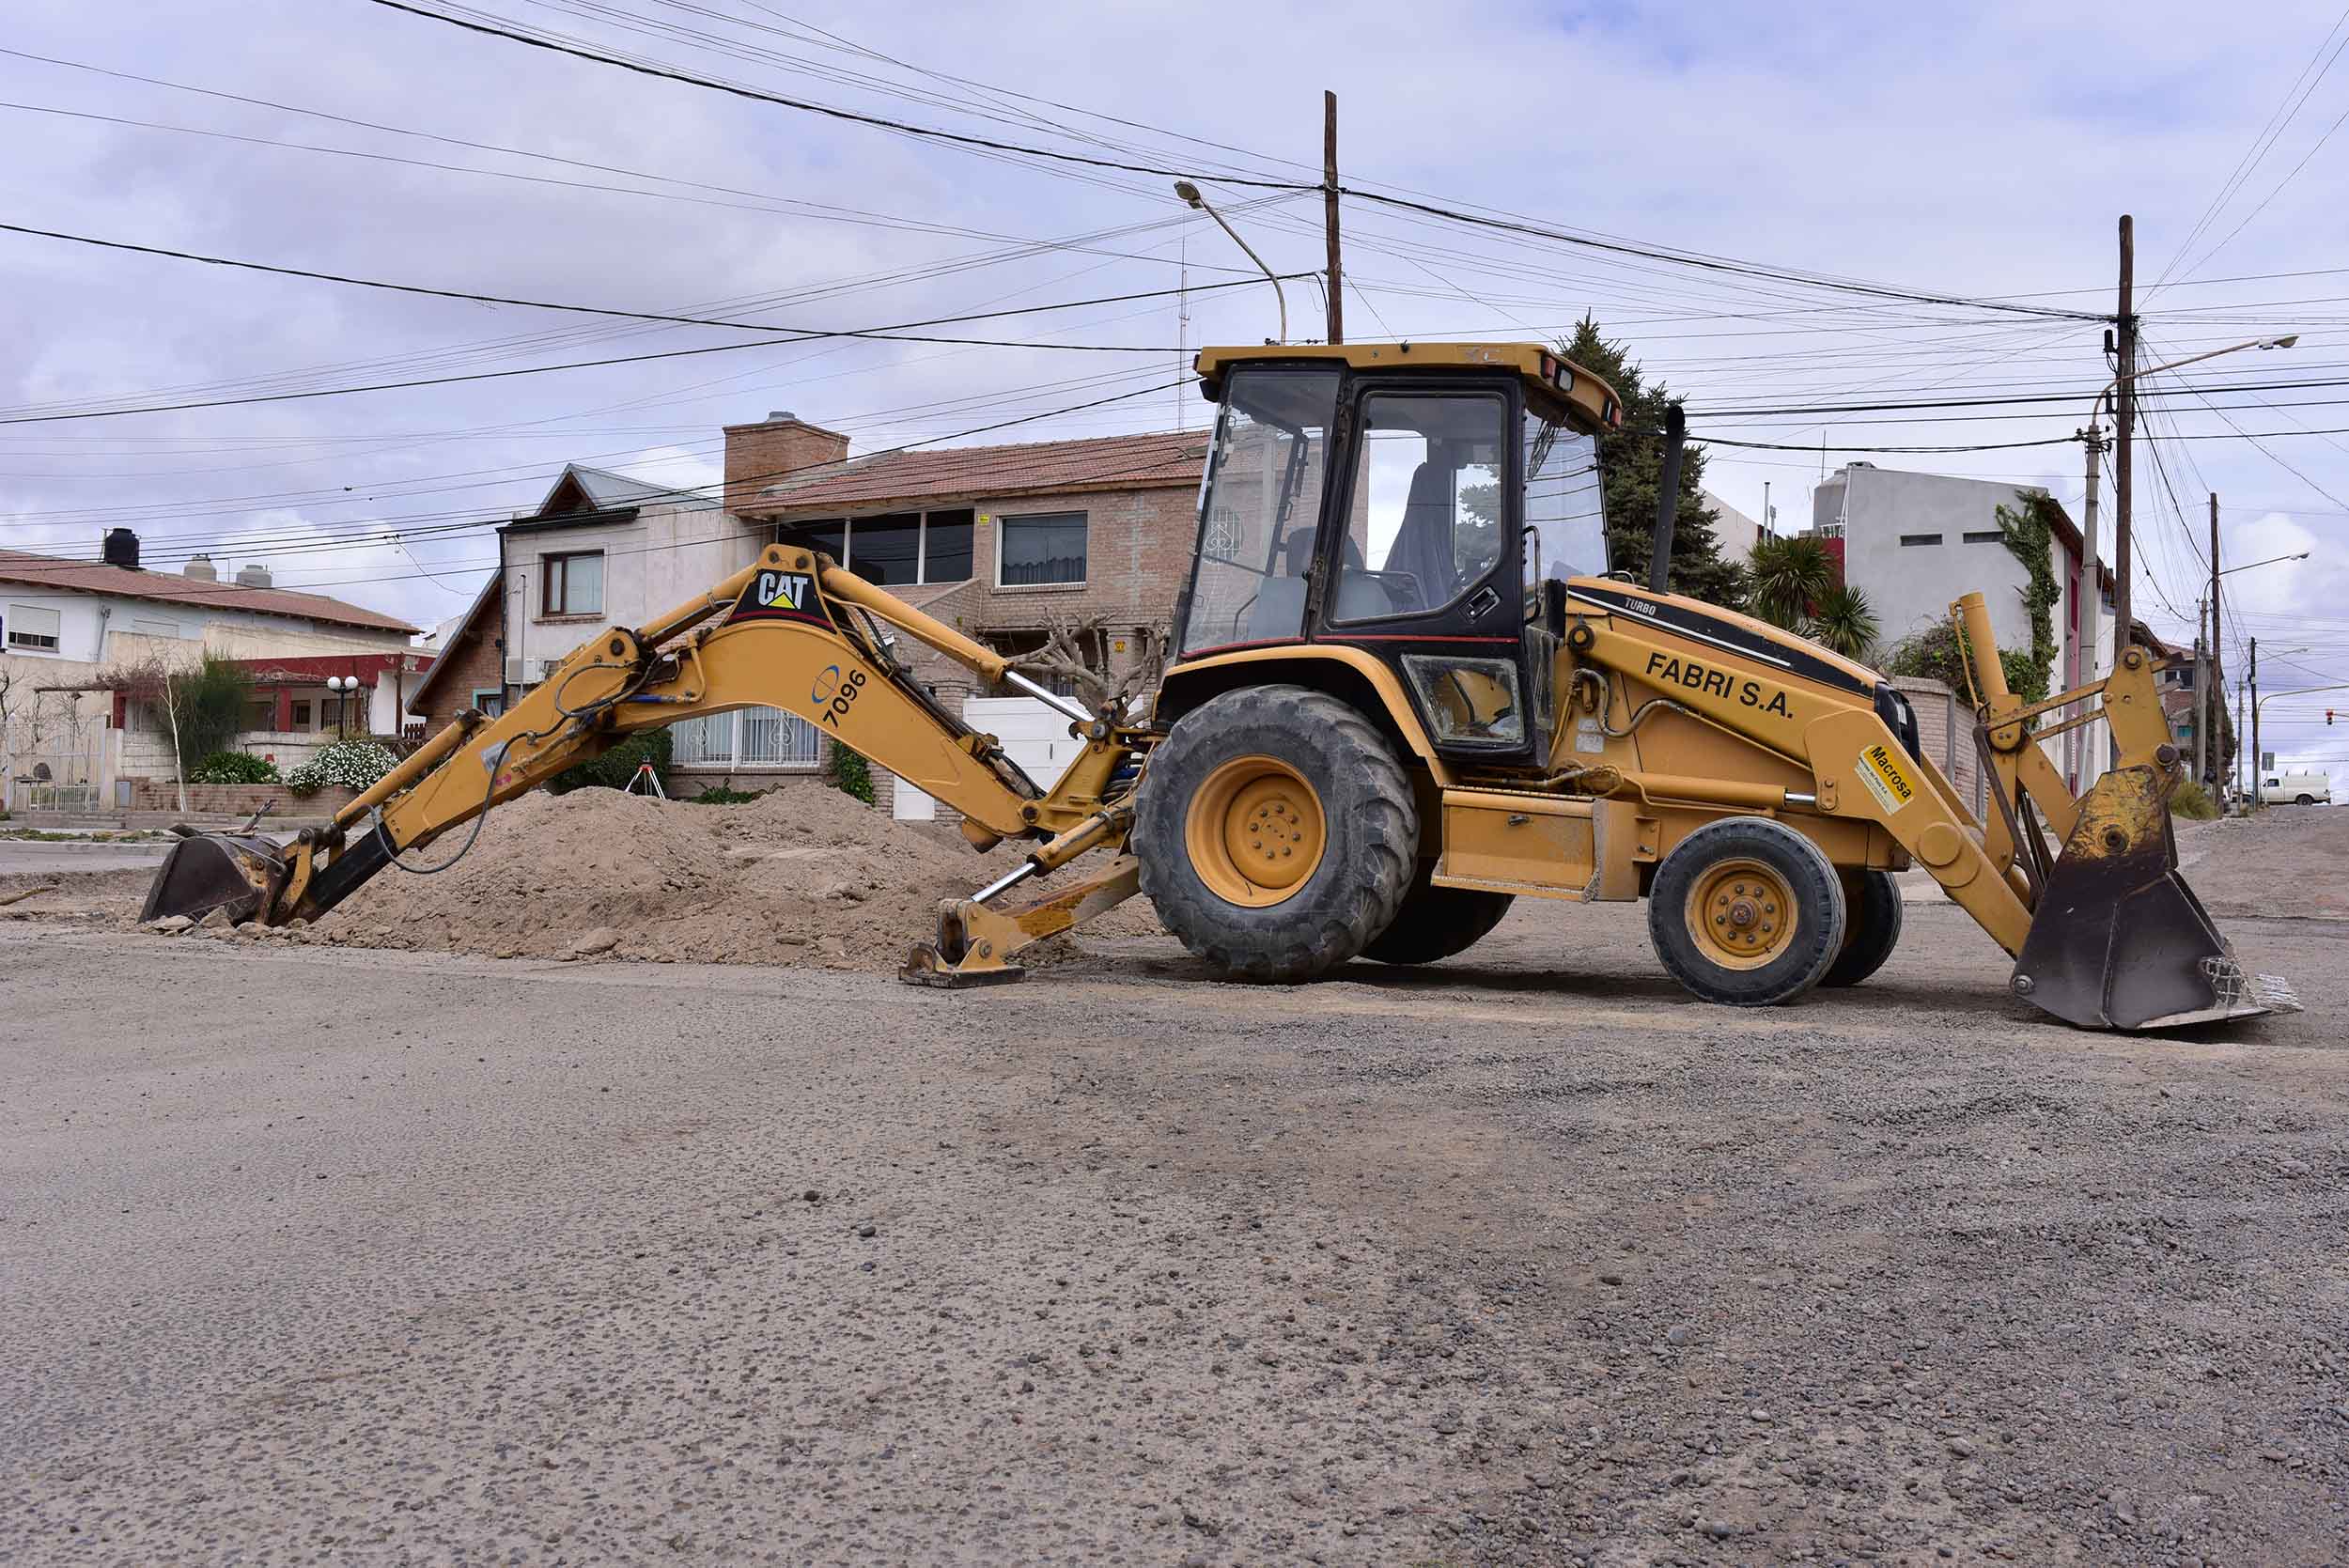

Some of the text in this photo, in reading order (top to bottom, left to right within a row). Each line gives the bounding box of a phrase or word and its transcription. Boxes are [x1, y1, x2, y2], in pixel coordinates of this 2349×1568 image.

[757, 572, 807, 609] CAT
[1626, 597, 1657, 615] TURBO
[822, 669, 866, 728] 7096
[1645, 652, 1793, 719] FABRI S.A.
[1871, 746, 1911, 798] Macrosa
